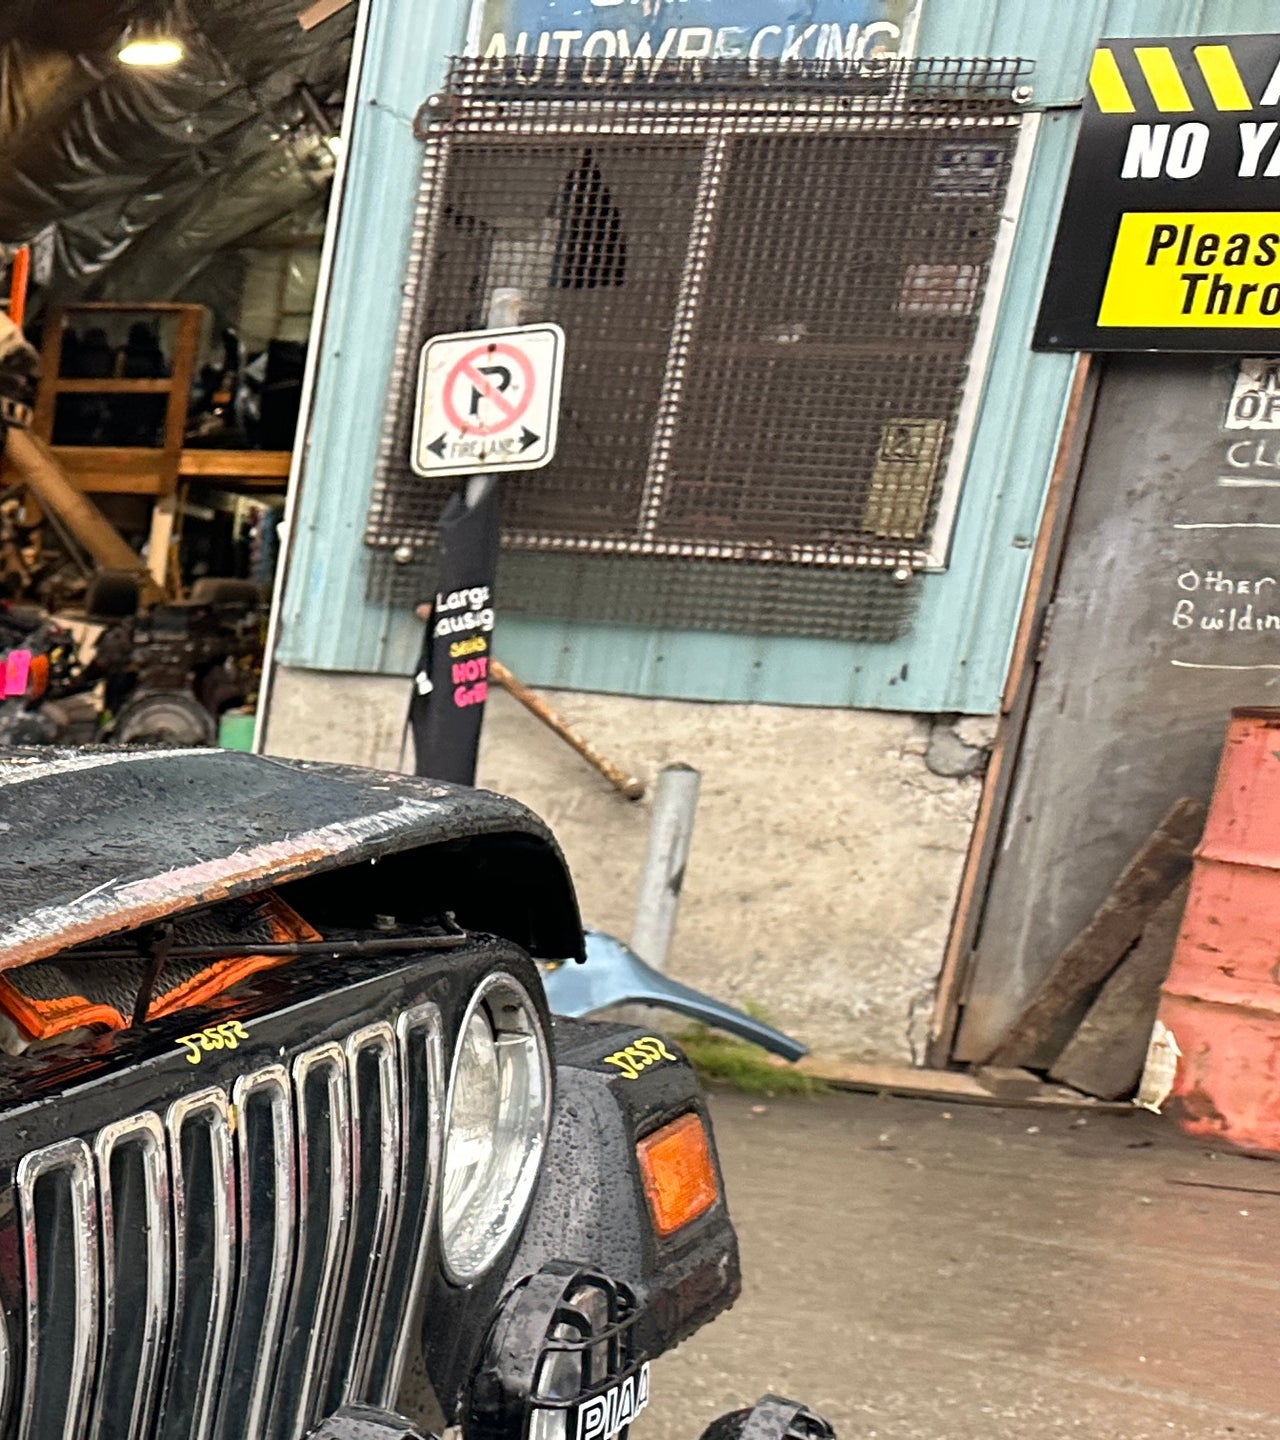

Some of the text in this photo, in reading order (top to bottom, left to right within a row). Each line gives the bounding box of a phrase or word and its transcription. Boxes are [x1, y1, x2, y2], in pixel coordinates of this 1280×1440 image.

[1120, 121, 1210, 179] NO
[1145, 223, 1280, 267] Pleas
[1180, 272, 1280, 316] Thro
[1227, 439, 1280, 468] CL
[1177, 570, 1277, 595] Other
[174, 1020, 249, 1064] J2552
[603, 1036, 677, 1079] J2552
